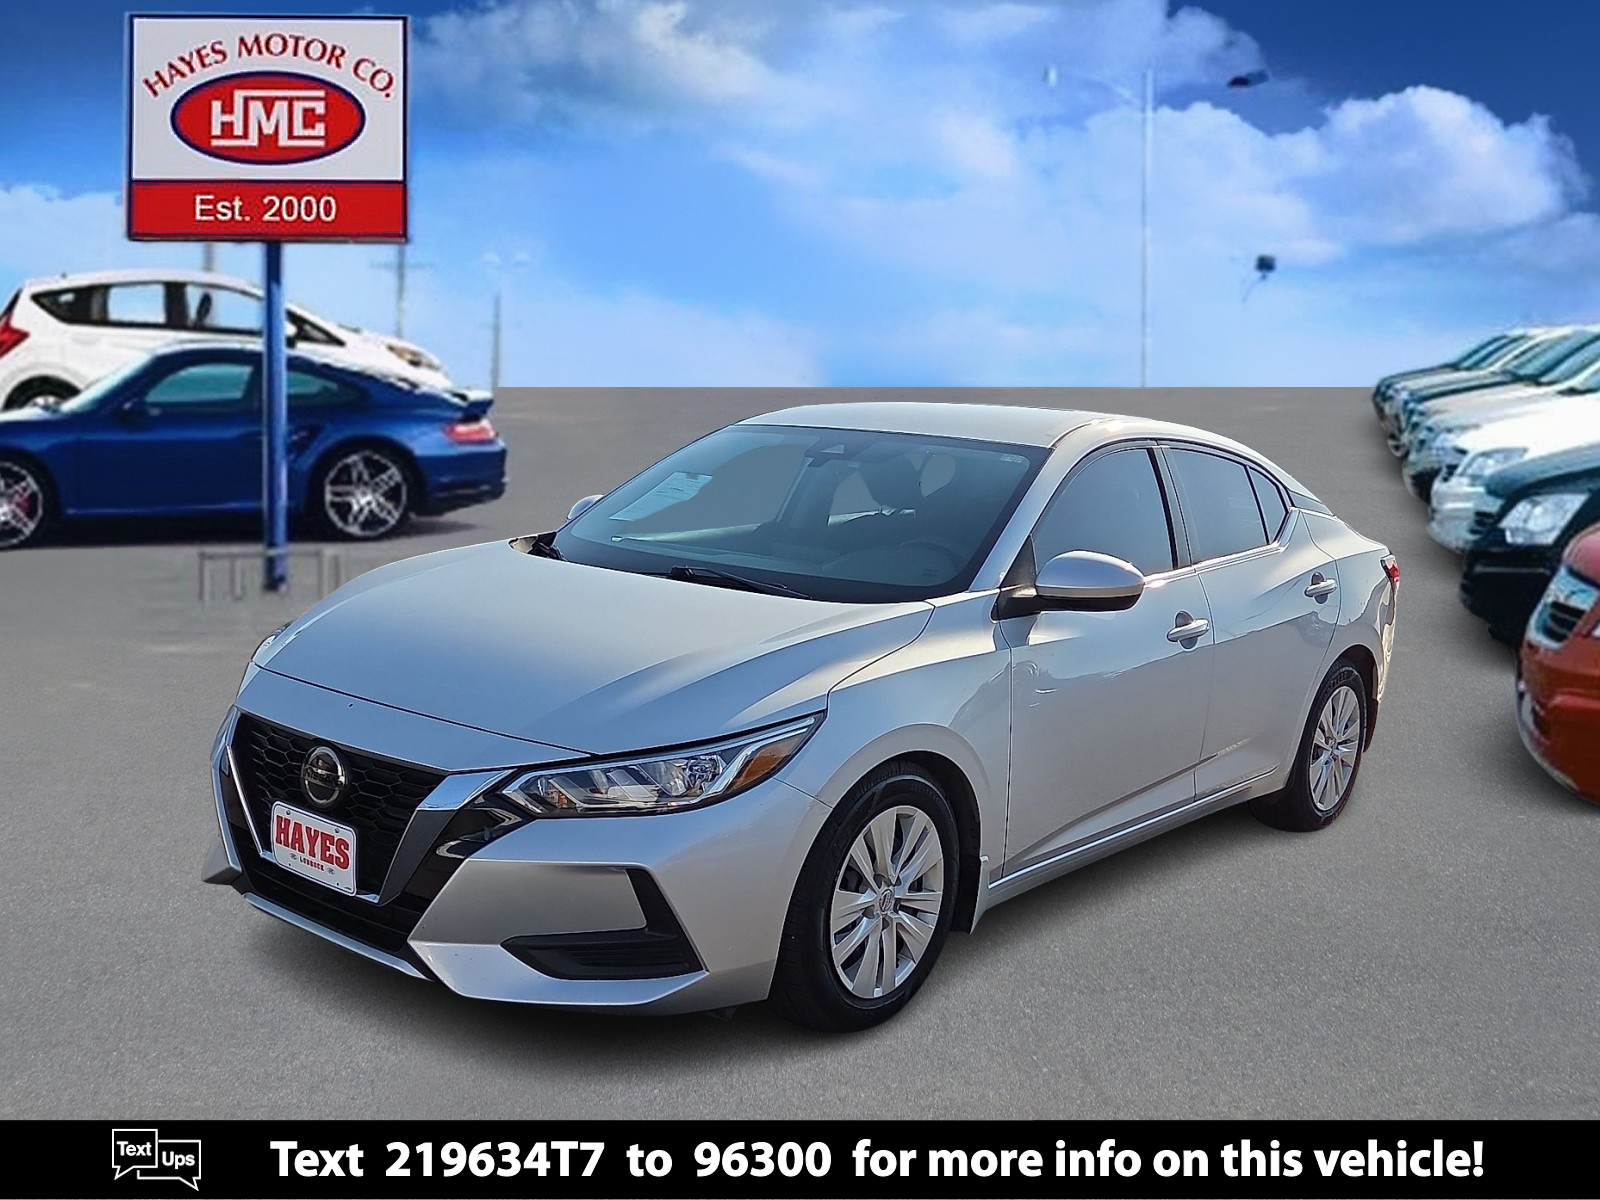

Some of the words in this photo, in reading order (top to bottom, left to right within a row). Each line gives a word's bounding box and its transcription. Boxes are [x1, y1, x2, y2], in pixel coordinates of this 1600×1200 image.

[143, 40, 228, 97] HAYES
[237, 33, 347, 69] MOTOR
[352, 57, 394, 98] CO.
[211, 89, 326, 147] HMC
[194, 194, 250, 222] Est.
[262, 195, 337, 222] 2000
[275, 814, 351, 870] HAYES
